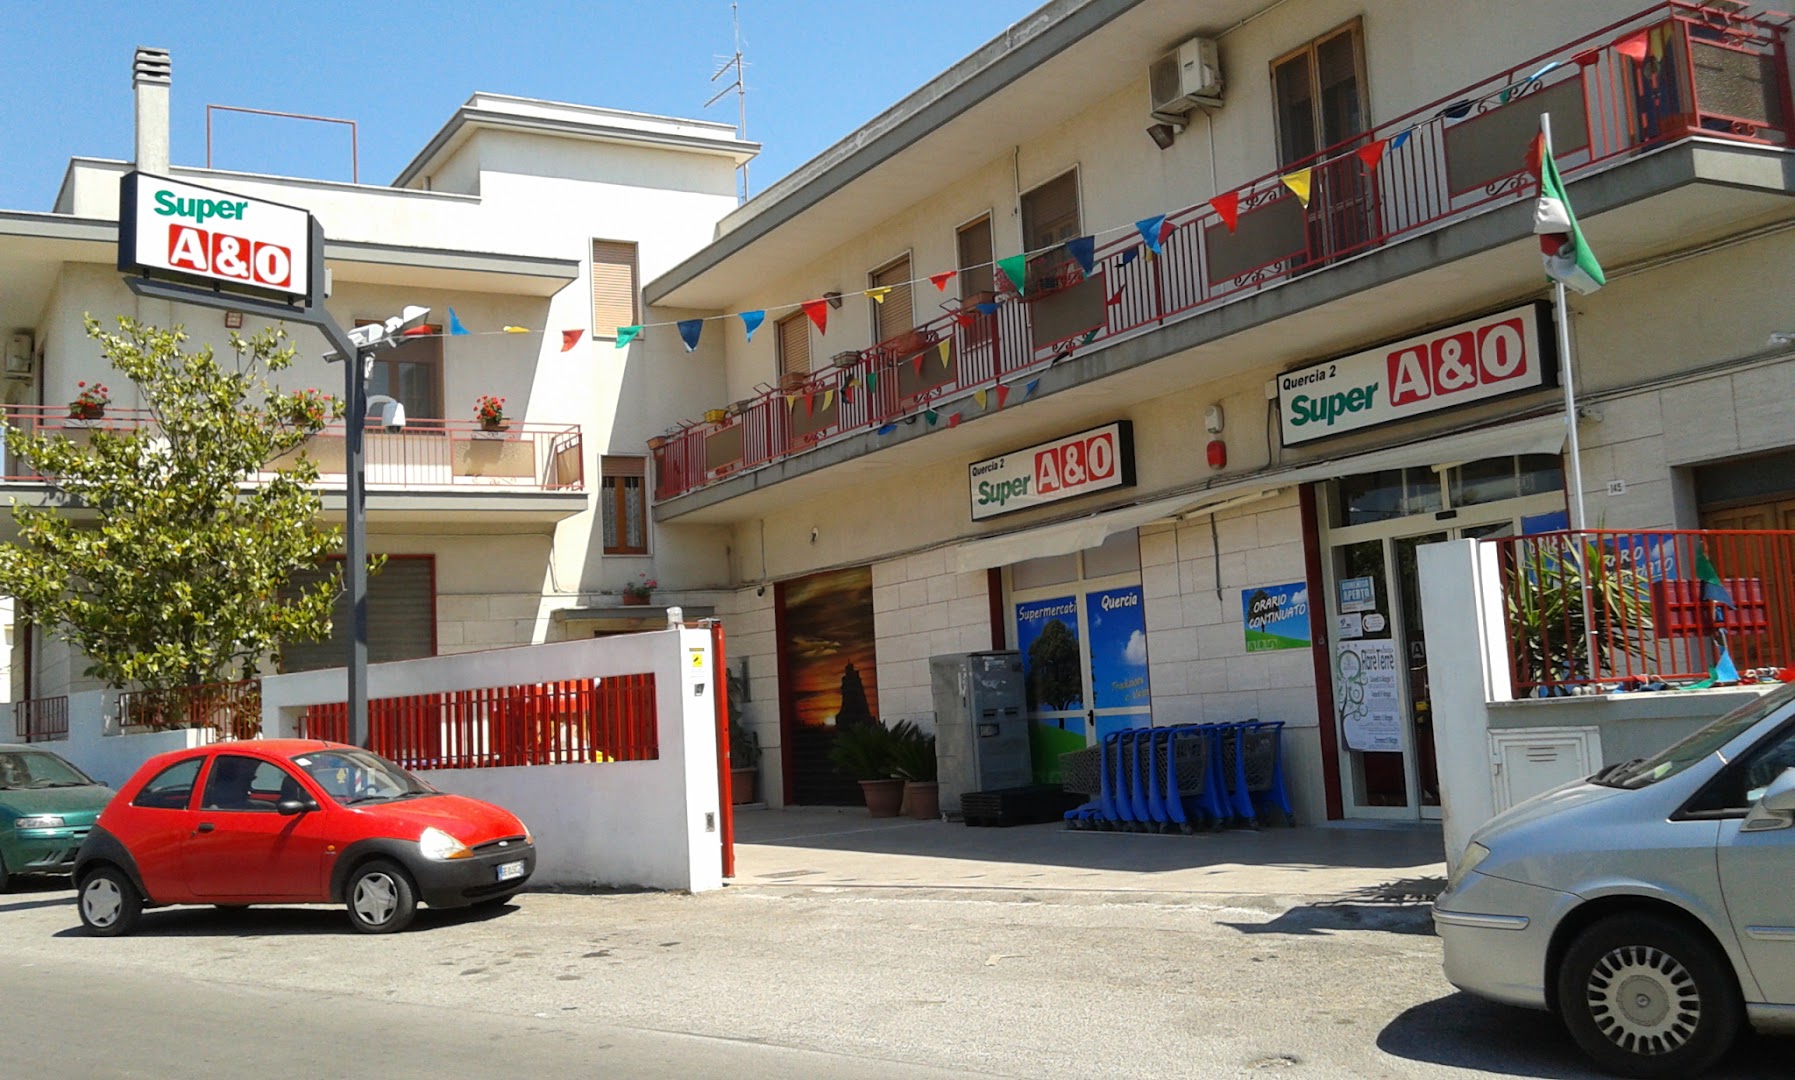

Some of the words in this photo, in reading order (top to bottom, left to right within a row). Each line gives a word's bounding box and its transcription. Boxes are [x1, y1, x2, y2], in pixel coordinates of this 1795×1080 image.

[154, 190, 248, 224] Super
[169, 224, 291, 288] A&O
[1282, 370, 1326, 391] Quercia
[1328, 365, 1337, 378] 2
[1289, 381, 1379, 427] Super
[1387, 318, 1527, 407] A&O
[972, 462, 998, 477] Quercia
[999, 458, 1005, 469] 2
[977, 474, 1031, 507] Super
[1034, 432, 1115, 495] A&O
[1101, 593, 1138, 611] Quercia
[1253, 594, 1287, 614] ORARIO
[1343, 588, 1370, 601] APERTO
[1248, 603, 1306, 629] CONTINUATO
